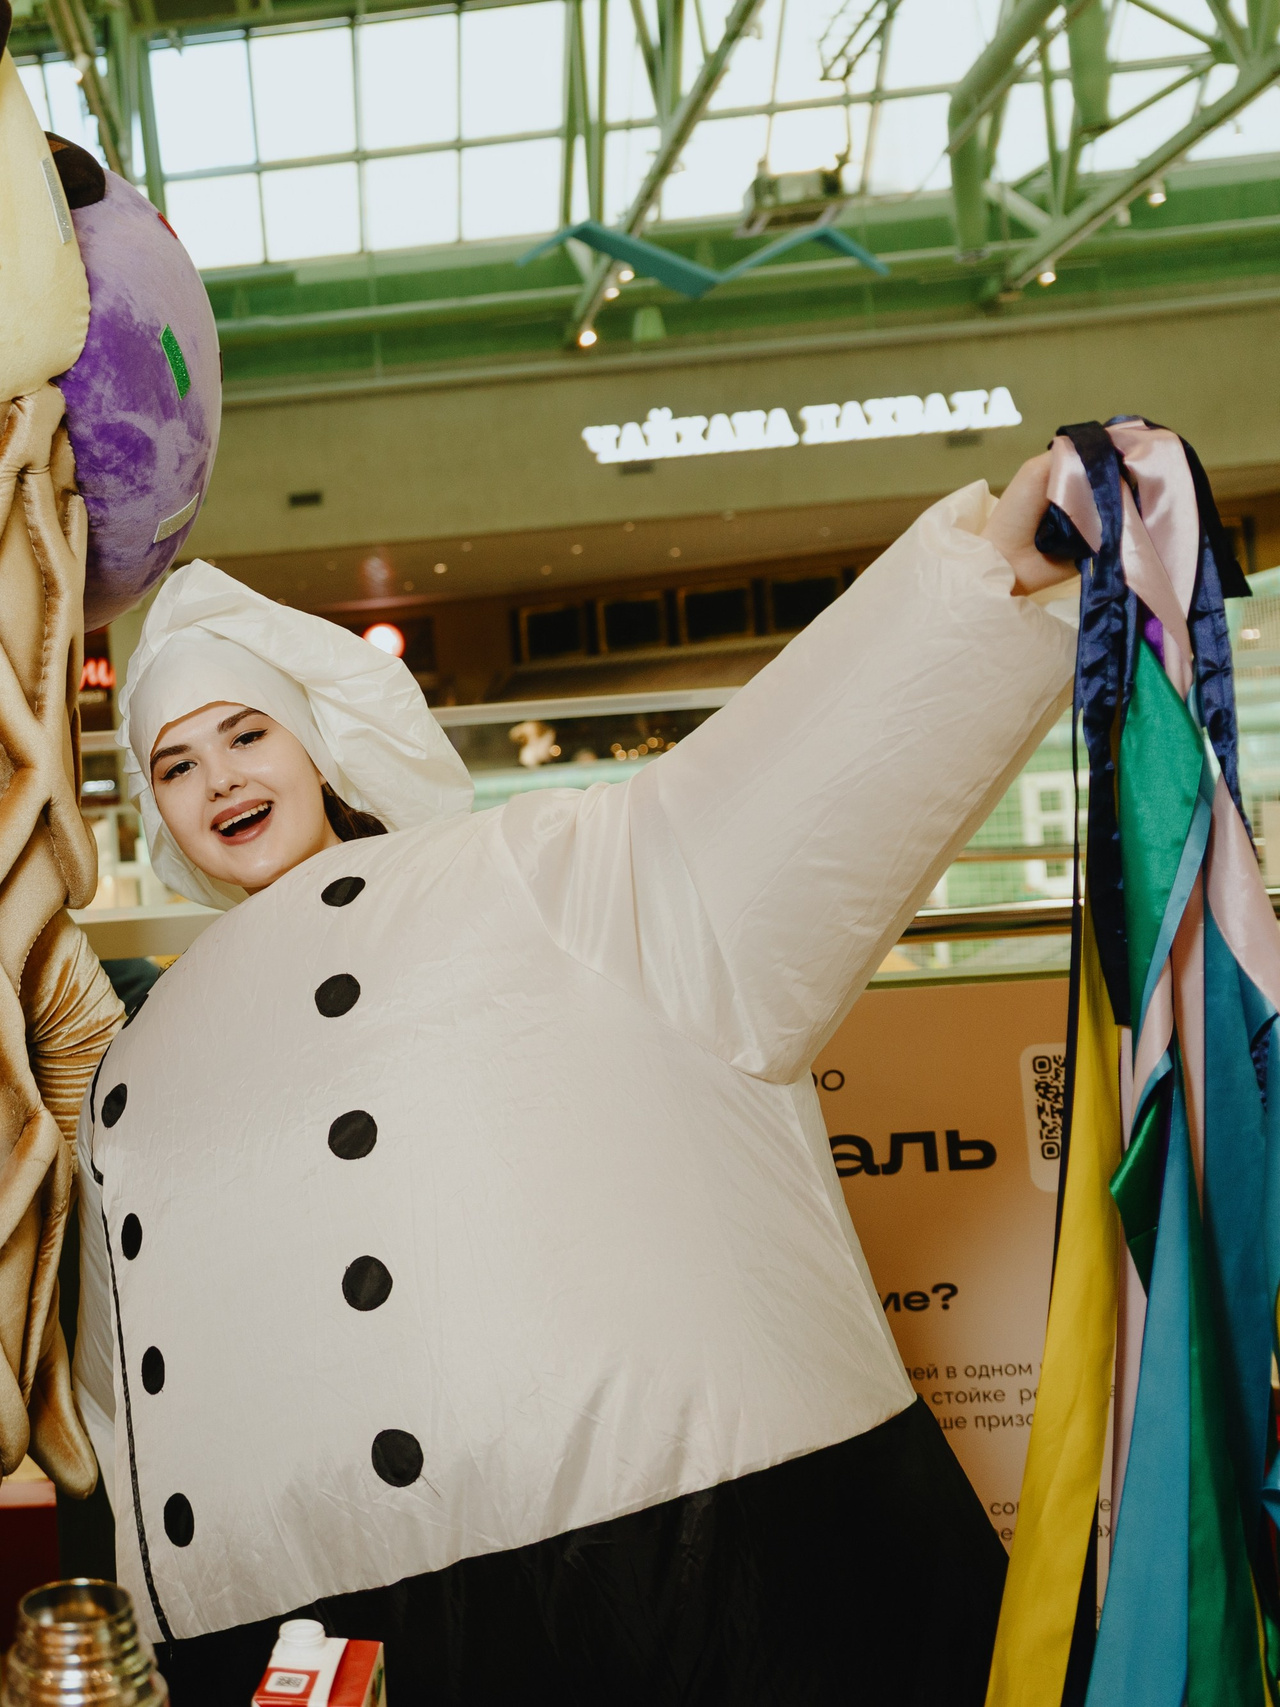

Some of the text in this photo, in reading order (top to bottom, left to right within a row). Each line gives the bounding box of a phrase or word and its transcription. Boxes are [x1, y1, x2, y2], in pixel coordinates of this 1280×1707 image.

[583, 407, 799, 463] ЧАЙХАНА
[946, 1365, 958, 1379] в
[964, 1363, 1034, 1381] одном
[931, 1386, 1006, 1405] стойке
[990, 1502, 1019, 1516] со
